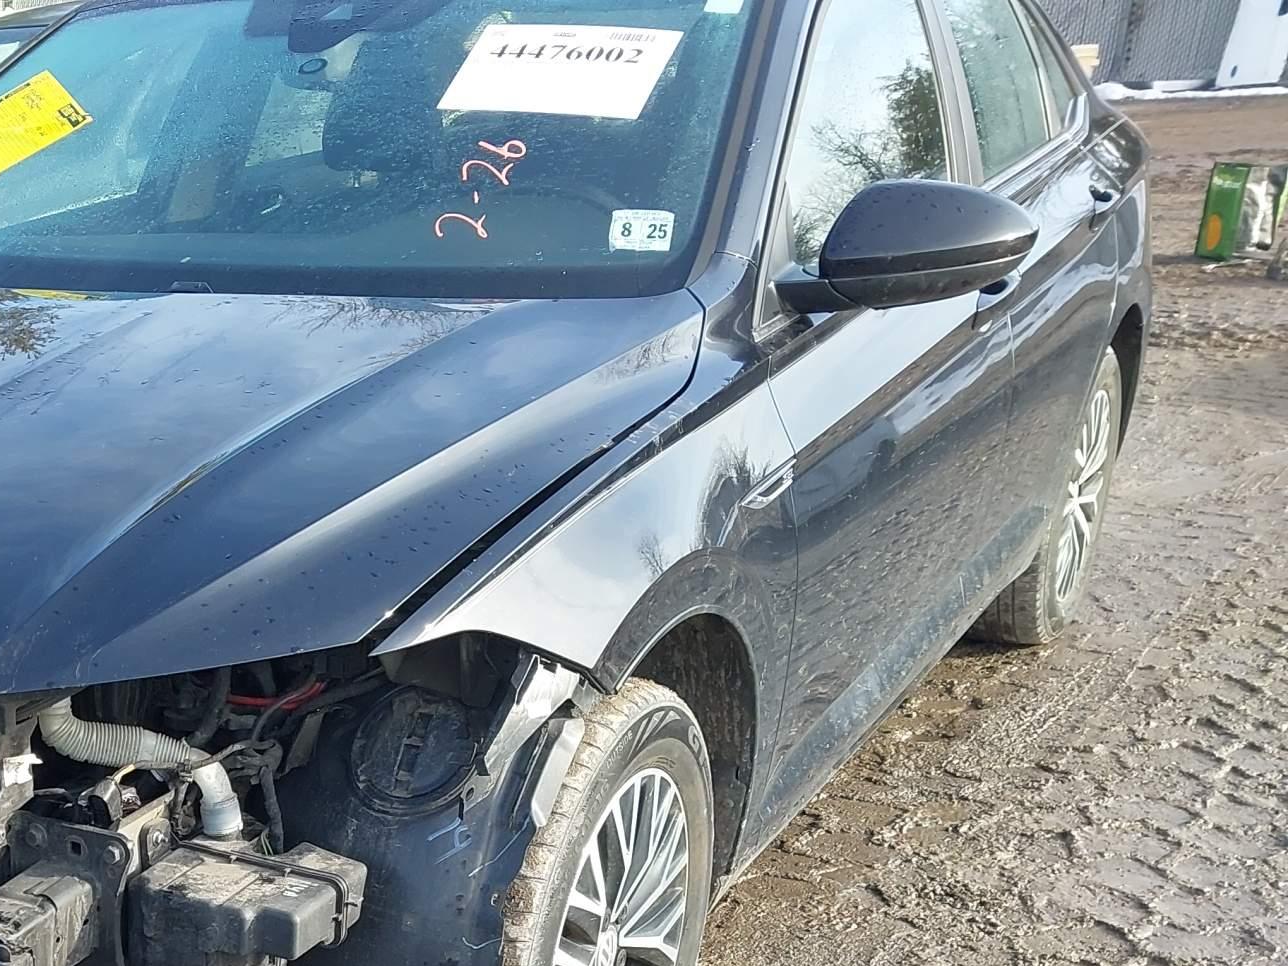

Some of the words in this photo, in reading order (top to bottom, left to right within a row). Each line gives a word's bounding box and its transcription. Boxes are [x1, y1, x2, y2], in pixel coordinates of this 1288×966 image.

[490, 43, 644, 64] 44476002
[435, 140, 527, 238] 2-26
[620, 222, 632, 237] 8
[646, 223, 668, 239] 25
[606, 730, 633, 769] OUTSIDE
